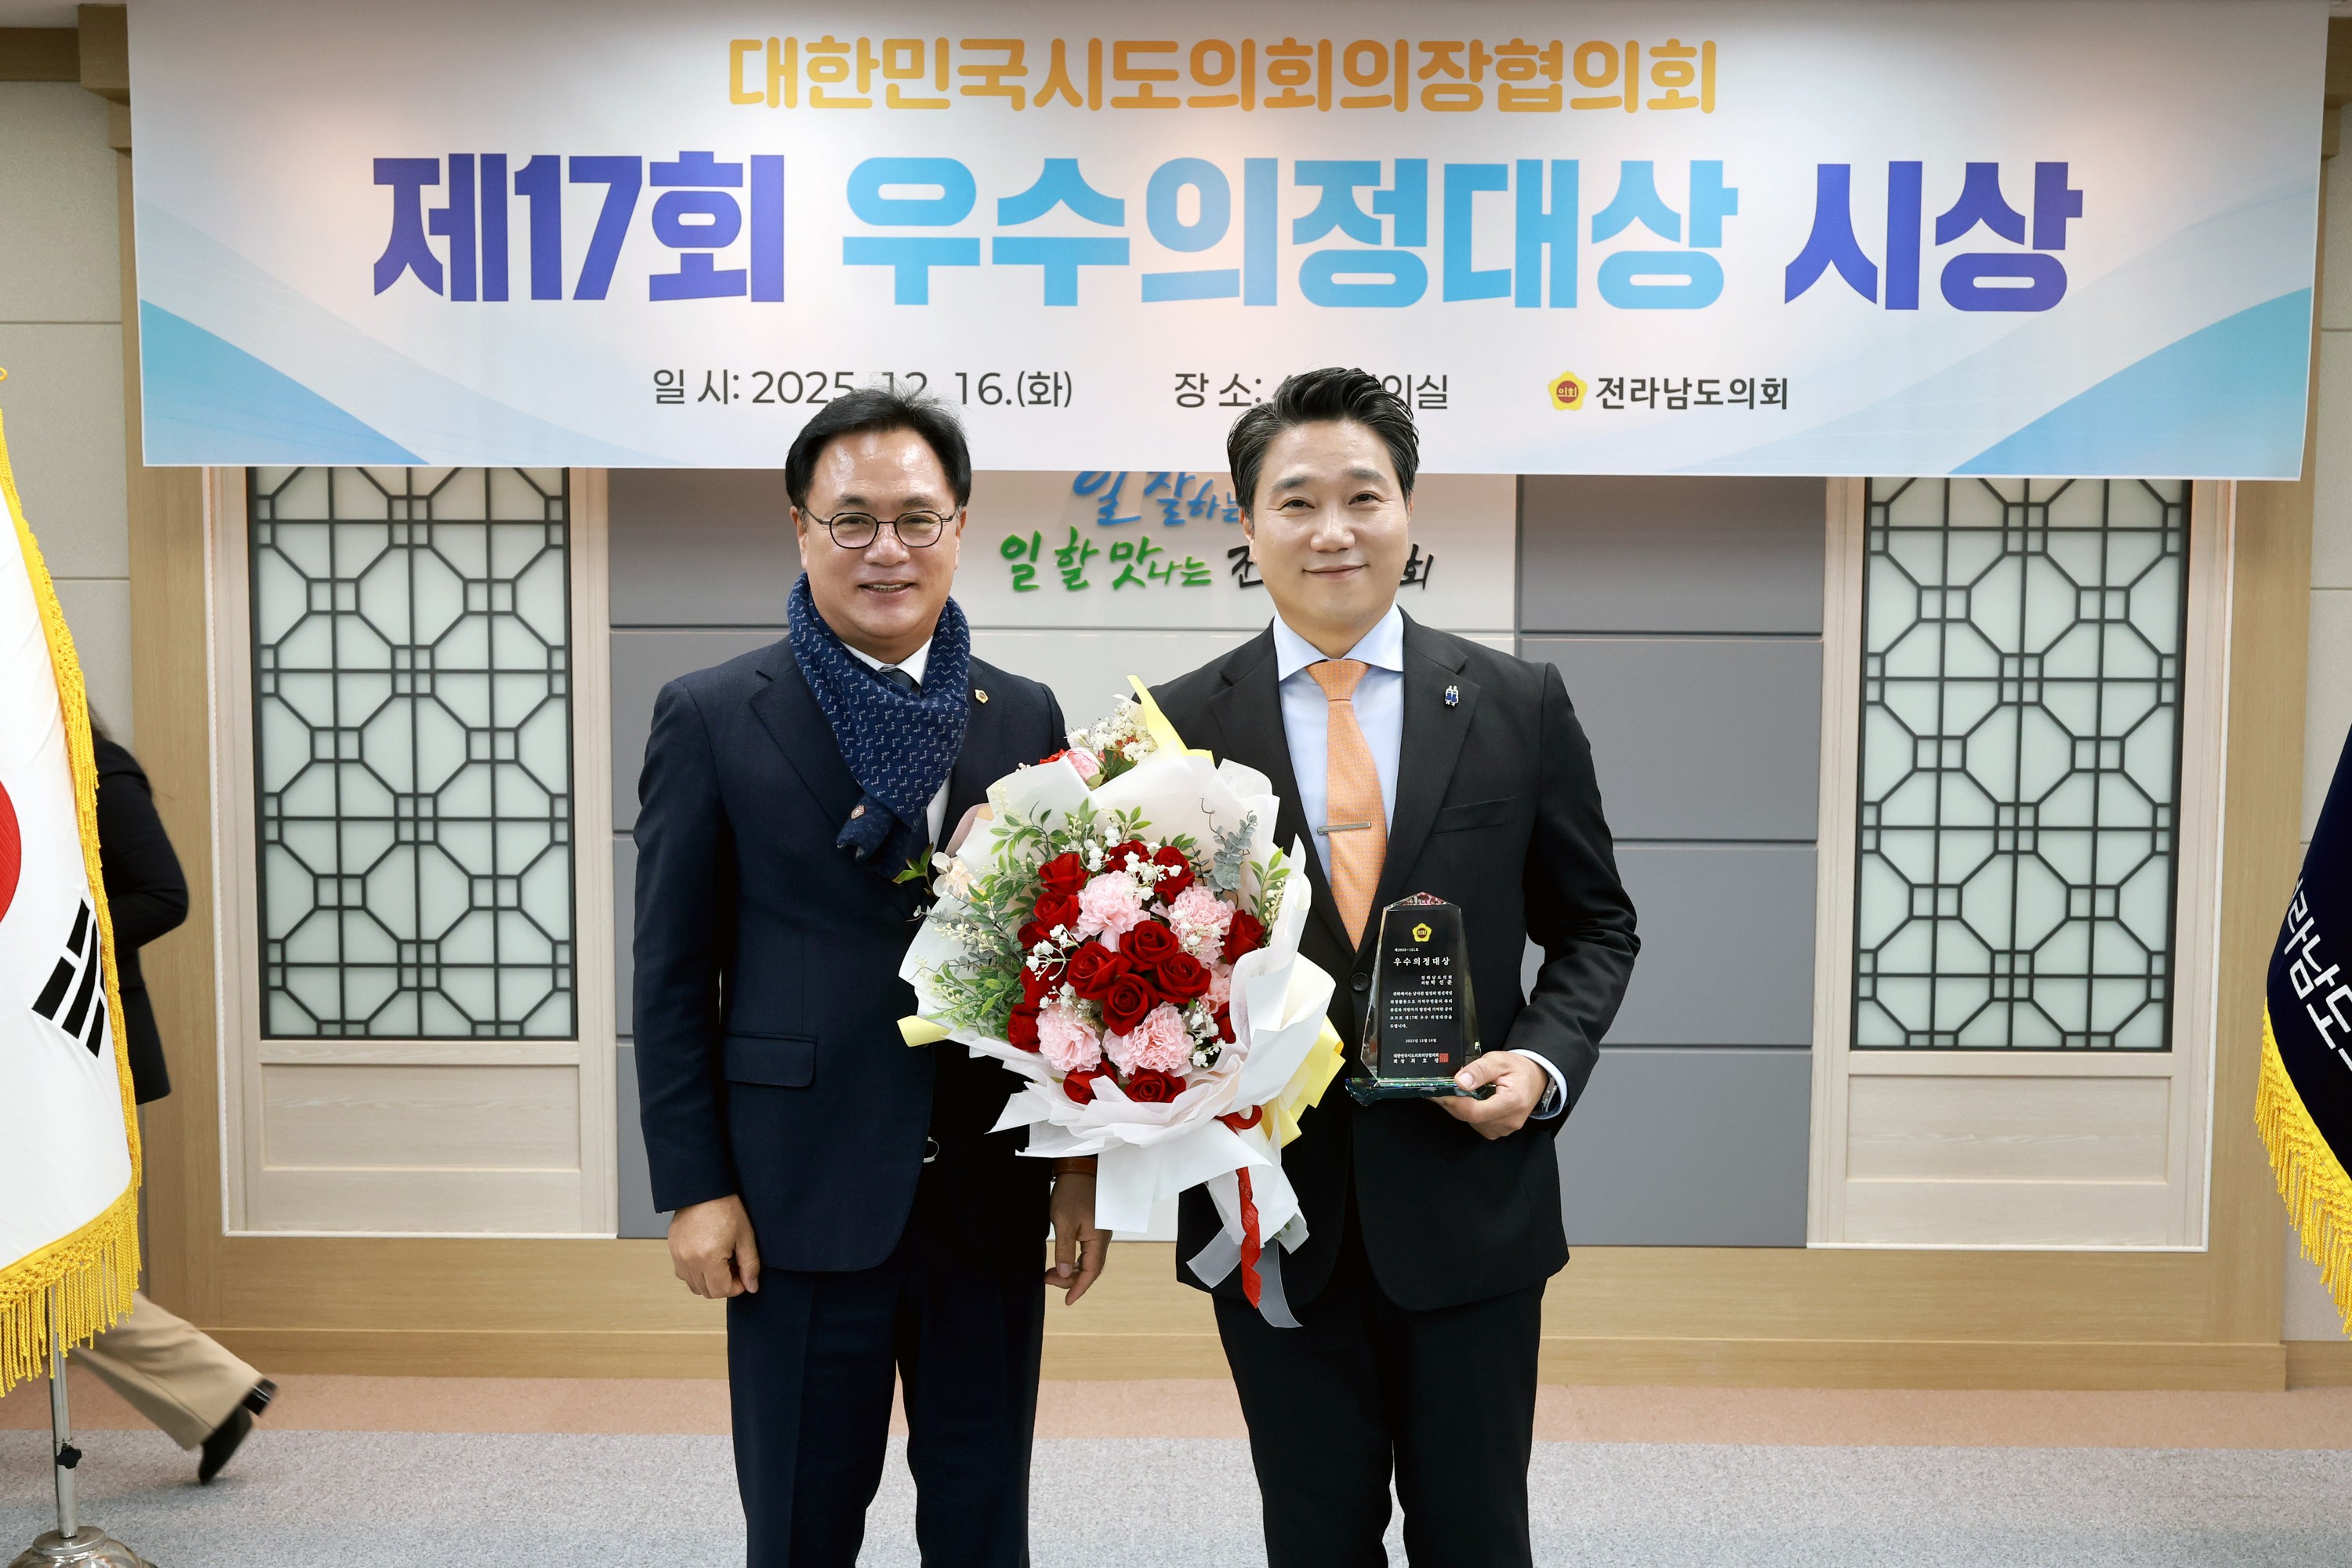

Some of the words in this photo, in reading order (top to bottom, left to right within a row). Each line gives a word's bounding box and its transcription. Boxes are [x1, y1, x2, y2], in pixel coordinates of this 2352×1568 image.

[729, 35, 1717, 114] 대한민국시도의회의장협의회
[374, 151, 784, 303] 제17회
[844, 158, 1739, 310] 우수의정대상
[1784, 161, 2083, 313] 시상
[653, 369, 685, 405] 일
[698, 369, 739, 405] 시:
[1174, 372, 1209, 408] 장
[1218, 372, 1262, 407] 소:
[1595, 377, 1788, 411] 전라남도의회
[1109, 535, 1212, 590] 맛나는
[1393, 956, 1450, 967] 우수의정대상
[2285, 877, 2352, 1072] 라남도
